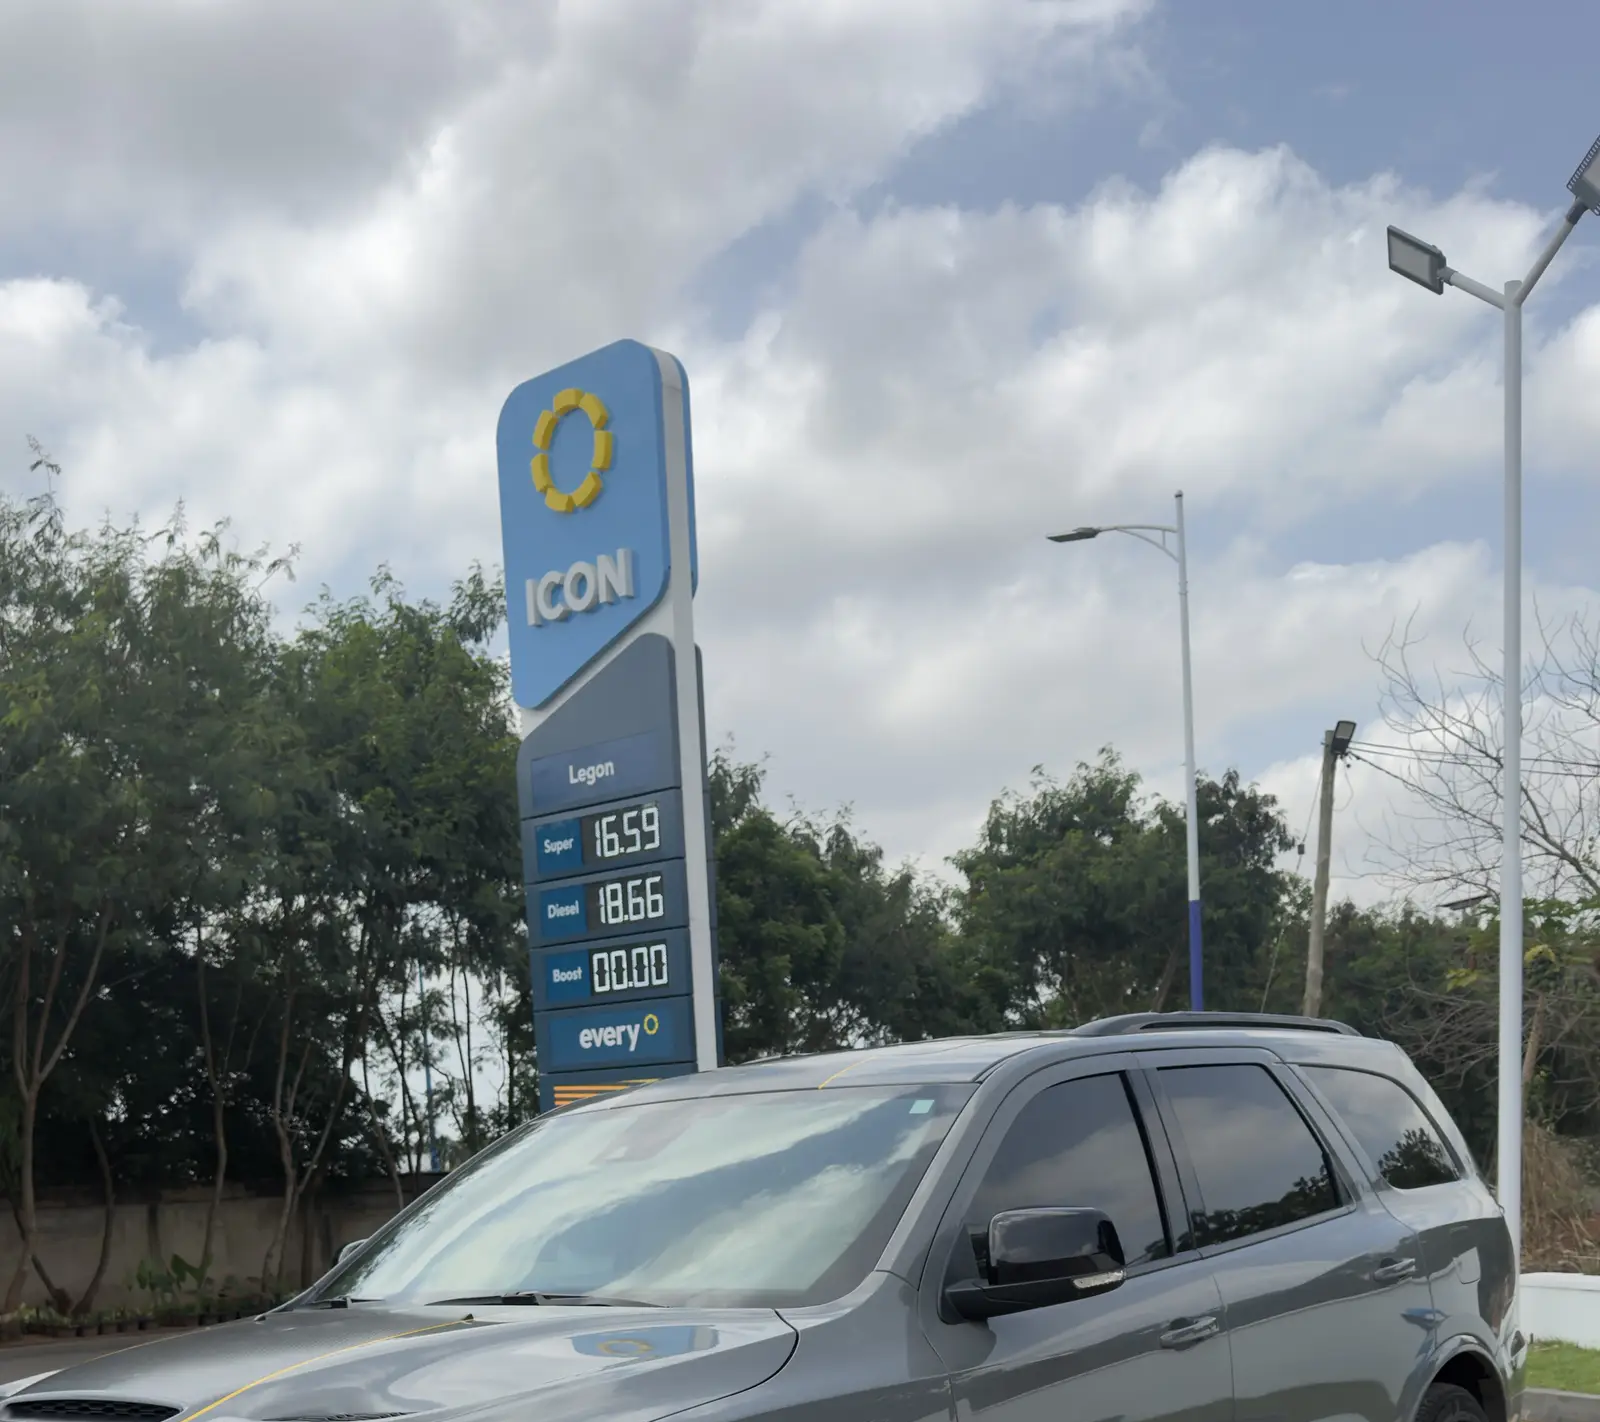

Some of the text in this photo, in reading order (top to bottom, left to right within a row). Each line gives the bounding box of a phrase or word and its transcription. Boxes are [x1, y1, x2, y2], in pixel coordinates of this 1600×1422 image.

[525, 548, 635, 628] ICON
[568, 760, 615, 786] Legon
[543, 806, 661, 858] Super 16.59
[547, 875, 664, 925] Diesel 18.66
[552, 943, 668, 993] Boost 00.00
